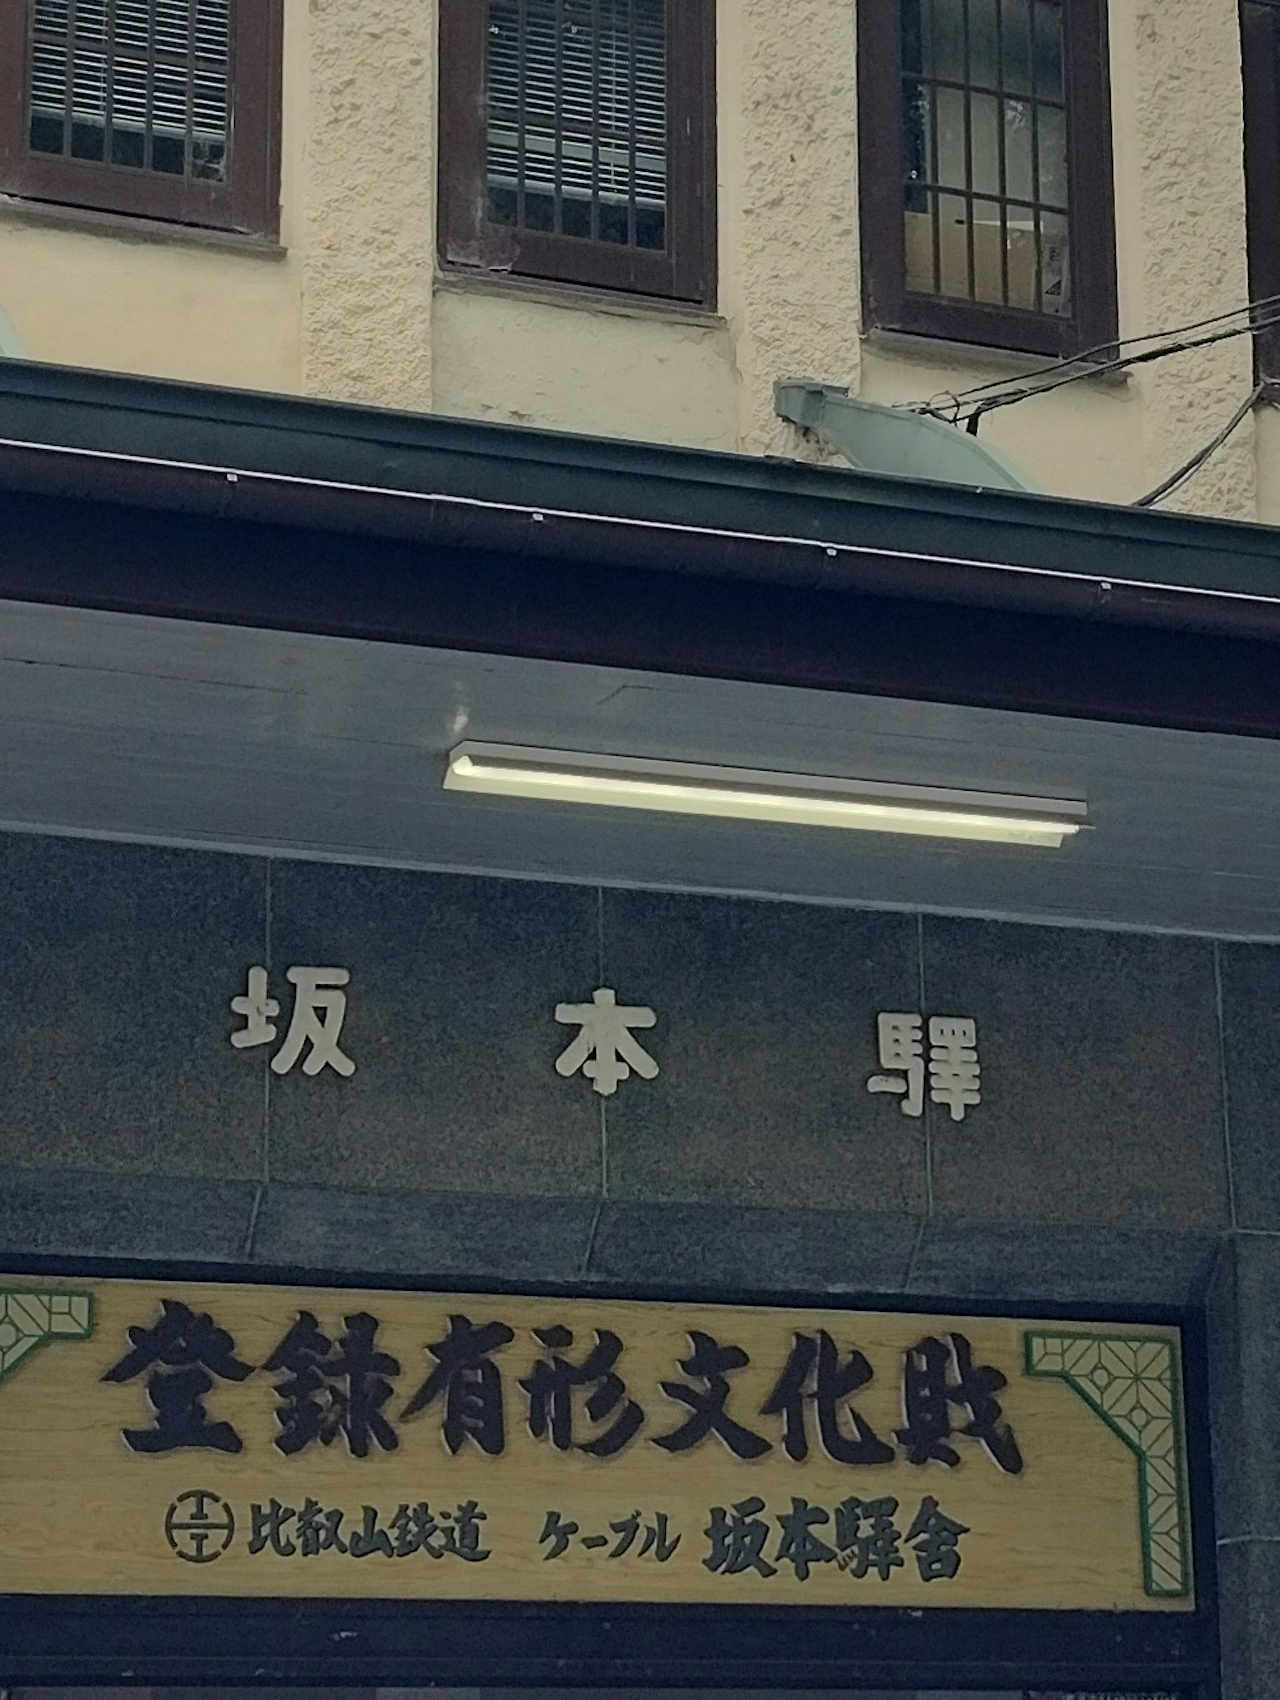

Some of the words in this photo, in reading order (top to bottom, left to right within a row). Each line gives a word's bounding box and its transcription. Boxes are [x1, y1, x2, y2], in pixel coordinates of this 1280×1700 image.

[230, 964, 982, 1122] 坂本驛
[248, 1496, 492, 1562] 比叡山鉄道
[538, 1509, 682, 1562] ケーブル
